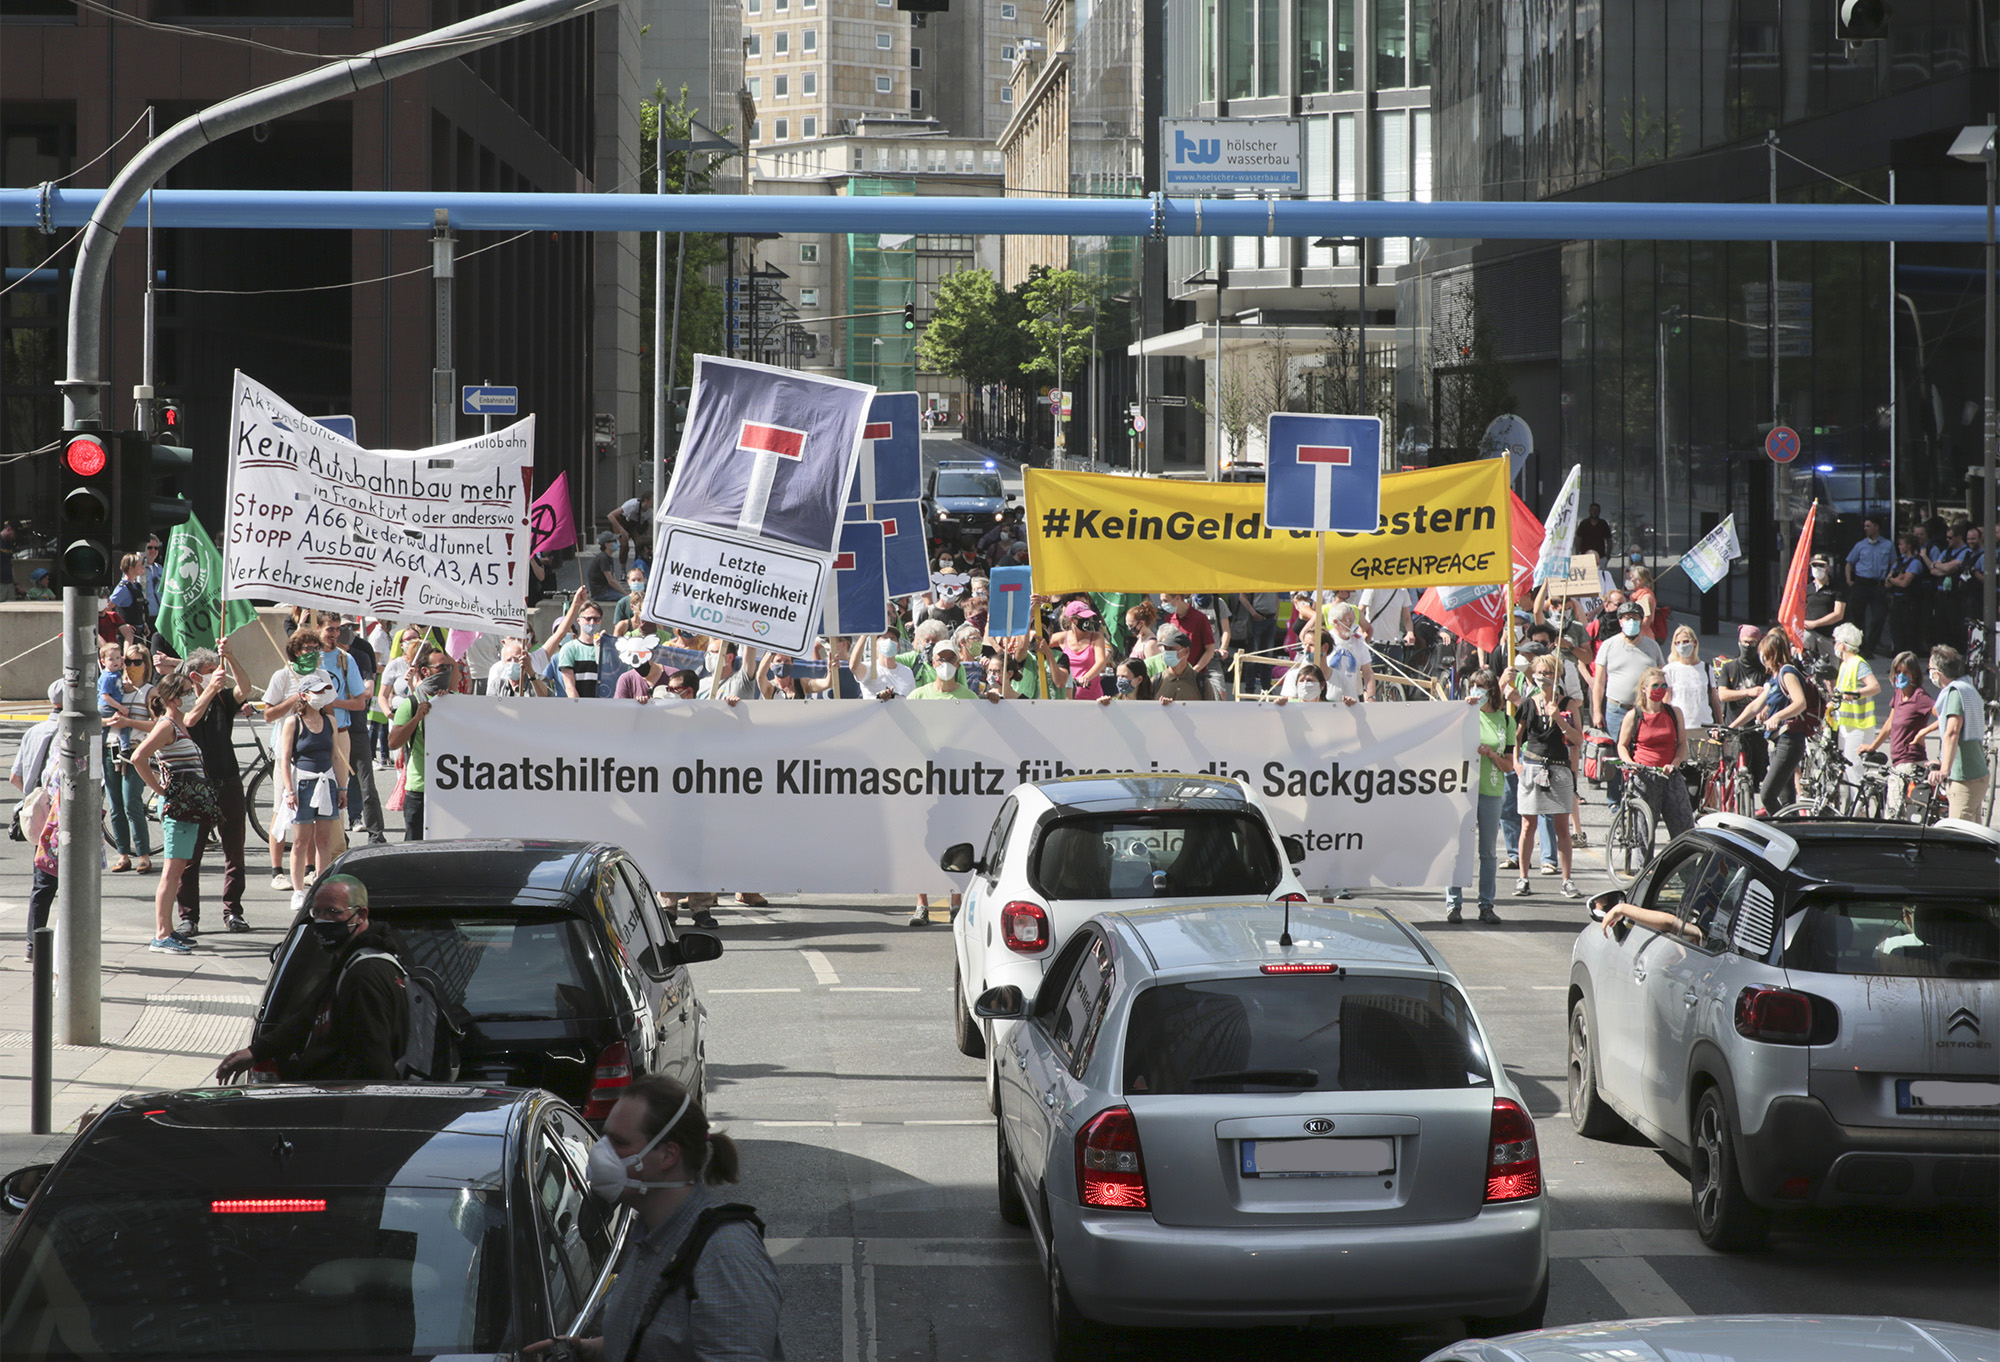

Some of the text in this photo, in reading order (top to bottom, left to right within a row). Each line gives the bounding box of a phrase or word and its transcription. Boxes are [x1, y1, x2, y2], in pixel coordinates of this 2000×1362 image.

[1227, 139, 1277, 151] hölscher
[1227, 153, 1290, 165] wasserbau
[1175, 174, 1291, 182] www.hoelscher-wasserbau.de
[238, 421, 517, 500] Kein Autobahnbau mehr
[314, 484, 328, 499] in
[332, 484, 407, 523] Frankfurt
[412, 504, 446, 525] oder
[452, 504, 514, 525] anderswo
[231, 522, 291, 548] Stopp
[297, 531, 376, 561] Ausbau
[234, 493, 293, 522] Stopp
[305, 505, 347, 529] A66
[354, 516, 493, 555] Riederwaldtunnel
[719, 552, 767, 576] Letzte
[1351, 551, 1495, 580] GREENPEACE
[183, 568, 207, 603] FUTURE
[230, 557, 364, 596] Verkehrswende
[419, 585, 484, 614] Grüngebiete
[487, 597, 526, 618] schützen
[670, 560, 808, 606] Wendemöglichkeit
[672, 581, 797, 623] #Verkehrswende
[689, 605, 723, 624] VCD
[436, 753, 659, 793] Staatshilfen
[673, 759, 763, 794] ohne
[776, 759, 1004, 796] Klimaschutz
[1263, 761, 1470, 803] Sackgasse!
[1309, 1122, 1329, 1131] KIA
[1246, 1160, 1252, 1168] D
